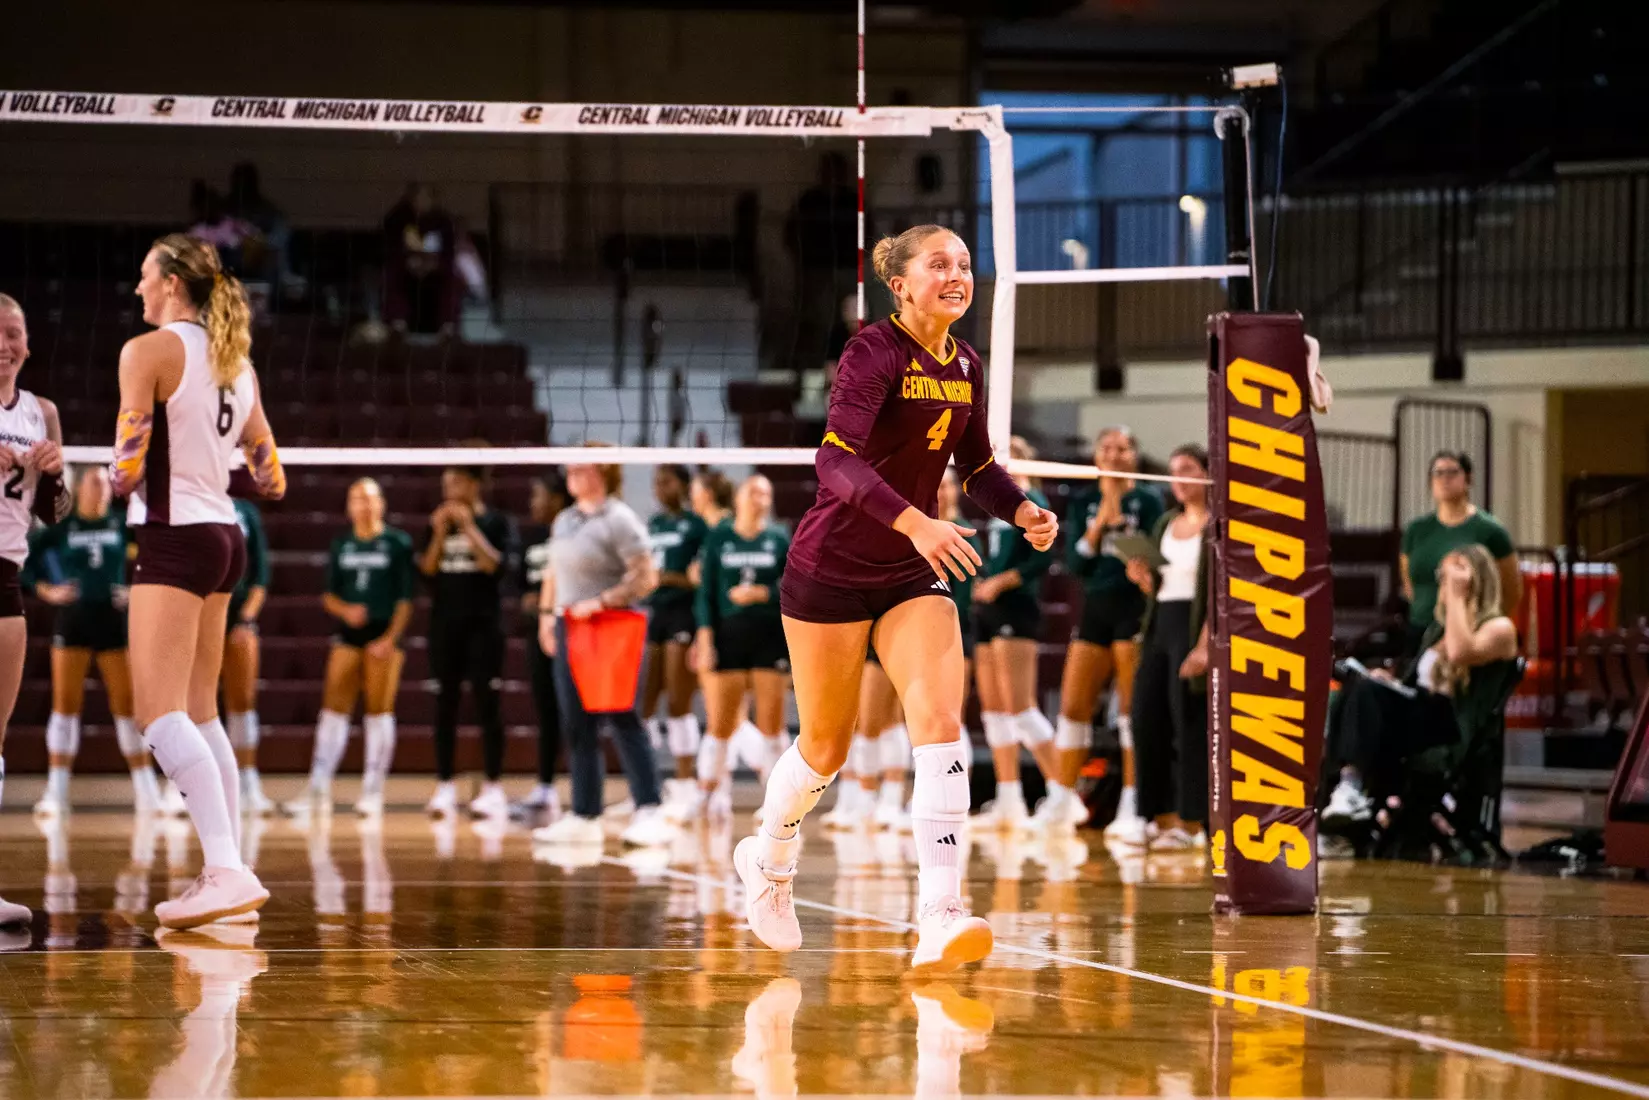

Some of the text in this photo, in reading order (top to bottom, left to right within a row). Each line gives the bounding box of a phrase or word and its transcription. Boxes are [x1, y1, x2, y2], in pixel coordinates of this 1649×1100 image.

[9, 94, 116, 115] VOLLEYBALL
[211, 98, 487, 123] CENTRAL MICHIGAN VOLLEYBALL
[577, 106, 844, 128] CENTRAL MICHIGAN VOLLEYBALL
[902, 375, 945, 400] CENTRAL
[216, 385, 235, 437] 6
[926, 408, 952, 450] 4
[1226, 357, 1312, 871] CHIPPEWAS
